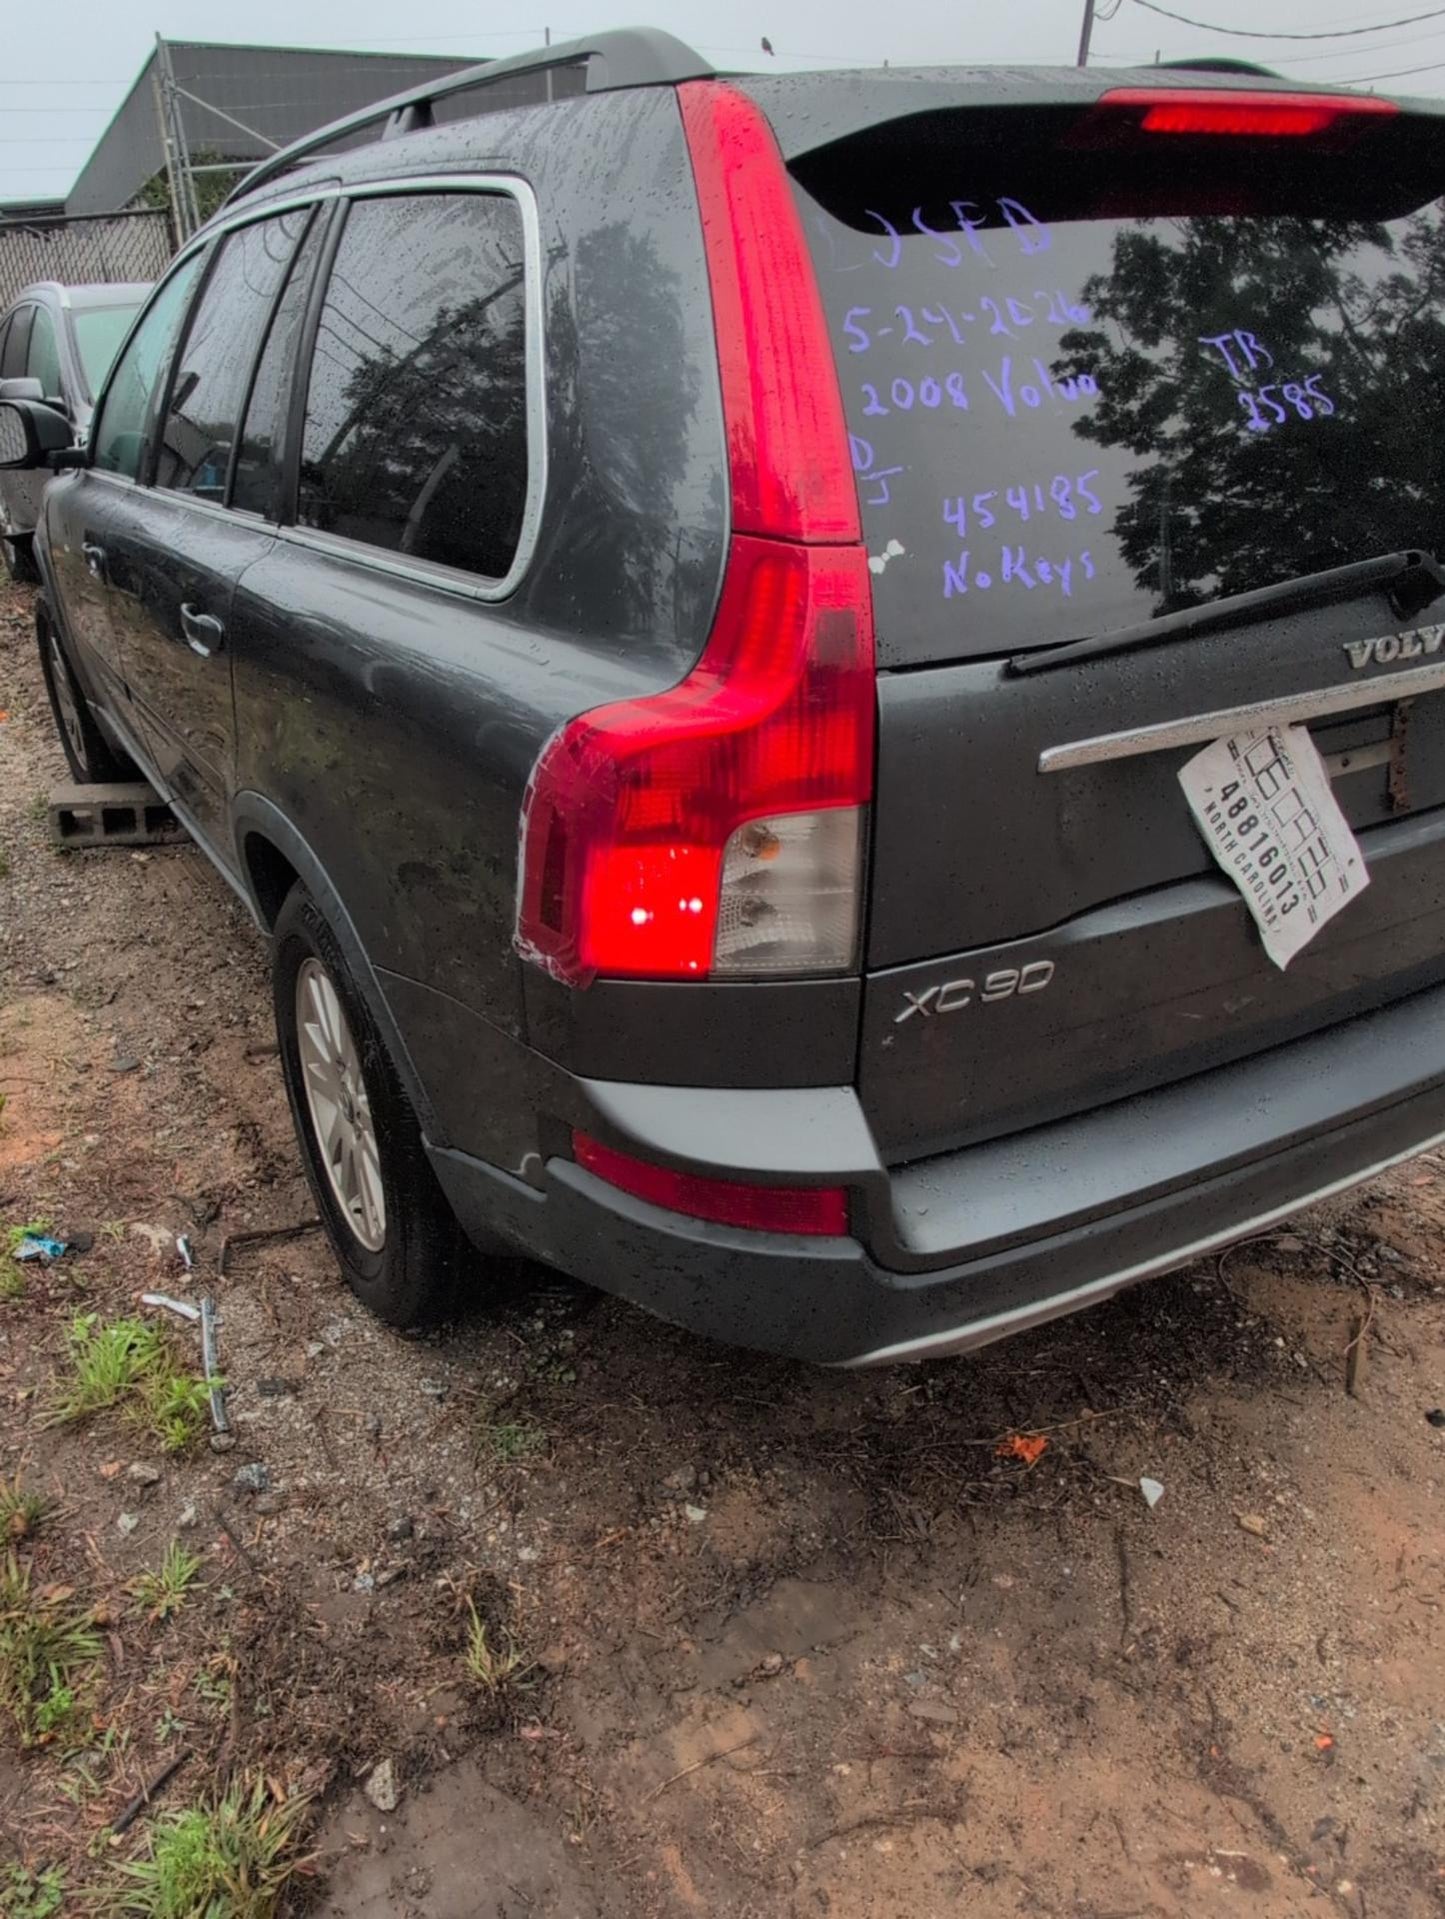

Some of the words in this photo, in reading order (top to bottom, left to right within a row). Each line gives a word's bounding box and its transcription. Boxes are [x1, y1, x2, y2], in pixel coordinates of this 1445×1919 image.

[861, 371, 969, 416] 2008
[982, 355, 1100, 418] Volvo
[1237, 373, 1335, 433] 2585
[943, 469, 1103, 538] 454185
[1204, 801, 1240, 853] NORTH
[1233, 852, 1278, 927] CAROLINA
[1221, 780, 1299, 916] 48816013
